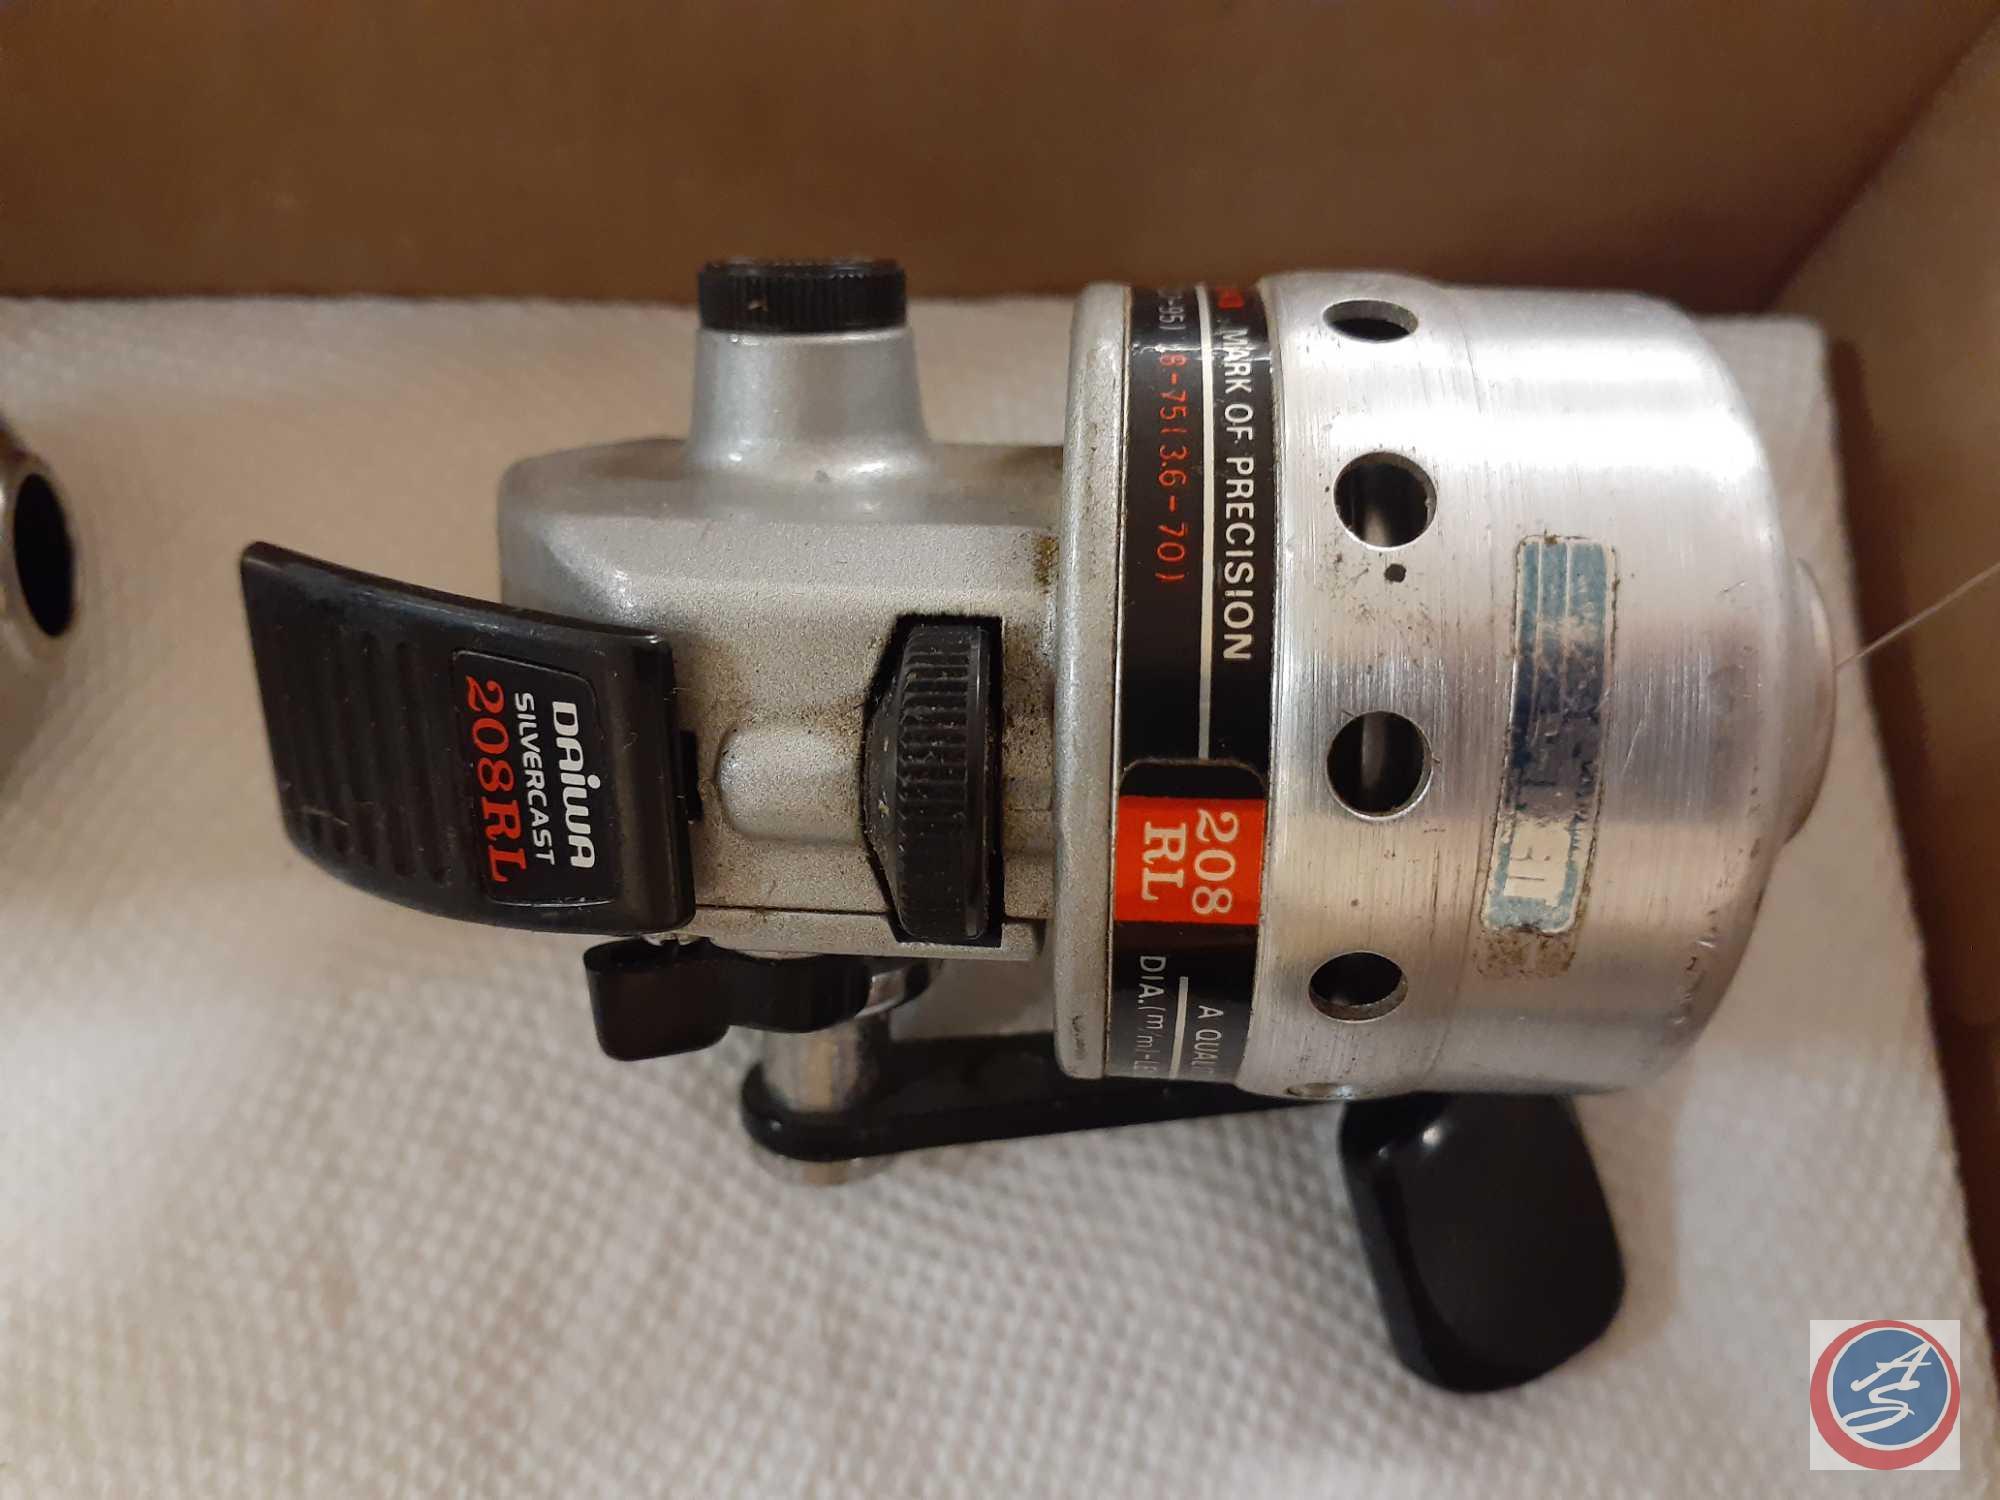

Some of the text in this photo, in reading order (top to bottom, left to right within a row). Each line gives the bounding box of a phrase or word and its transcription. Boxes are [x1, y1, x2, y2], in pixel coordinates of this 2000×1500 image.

[1222, 328, 1252, 394] MARK
[1224, 403, 1254, 441] OF
[1223, 456, 1255, 660] PRECISION
[465, 675, 527, 883] 208RL
[514, 692, 555, 866] SILVERCAST
[1141, 821, 1186, 901] RL
[1191, 808, 1239, 915] 208
[1198, 1005, 1225, 1019] A
